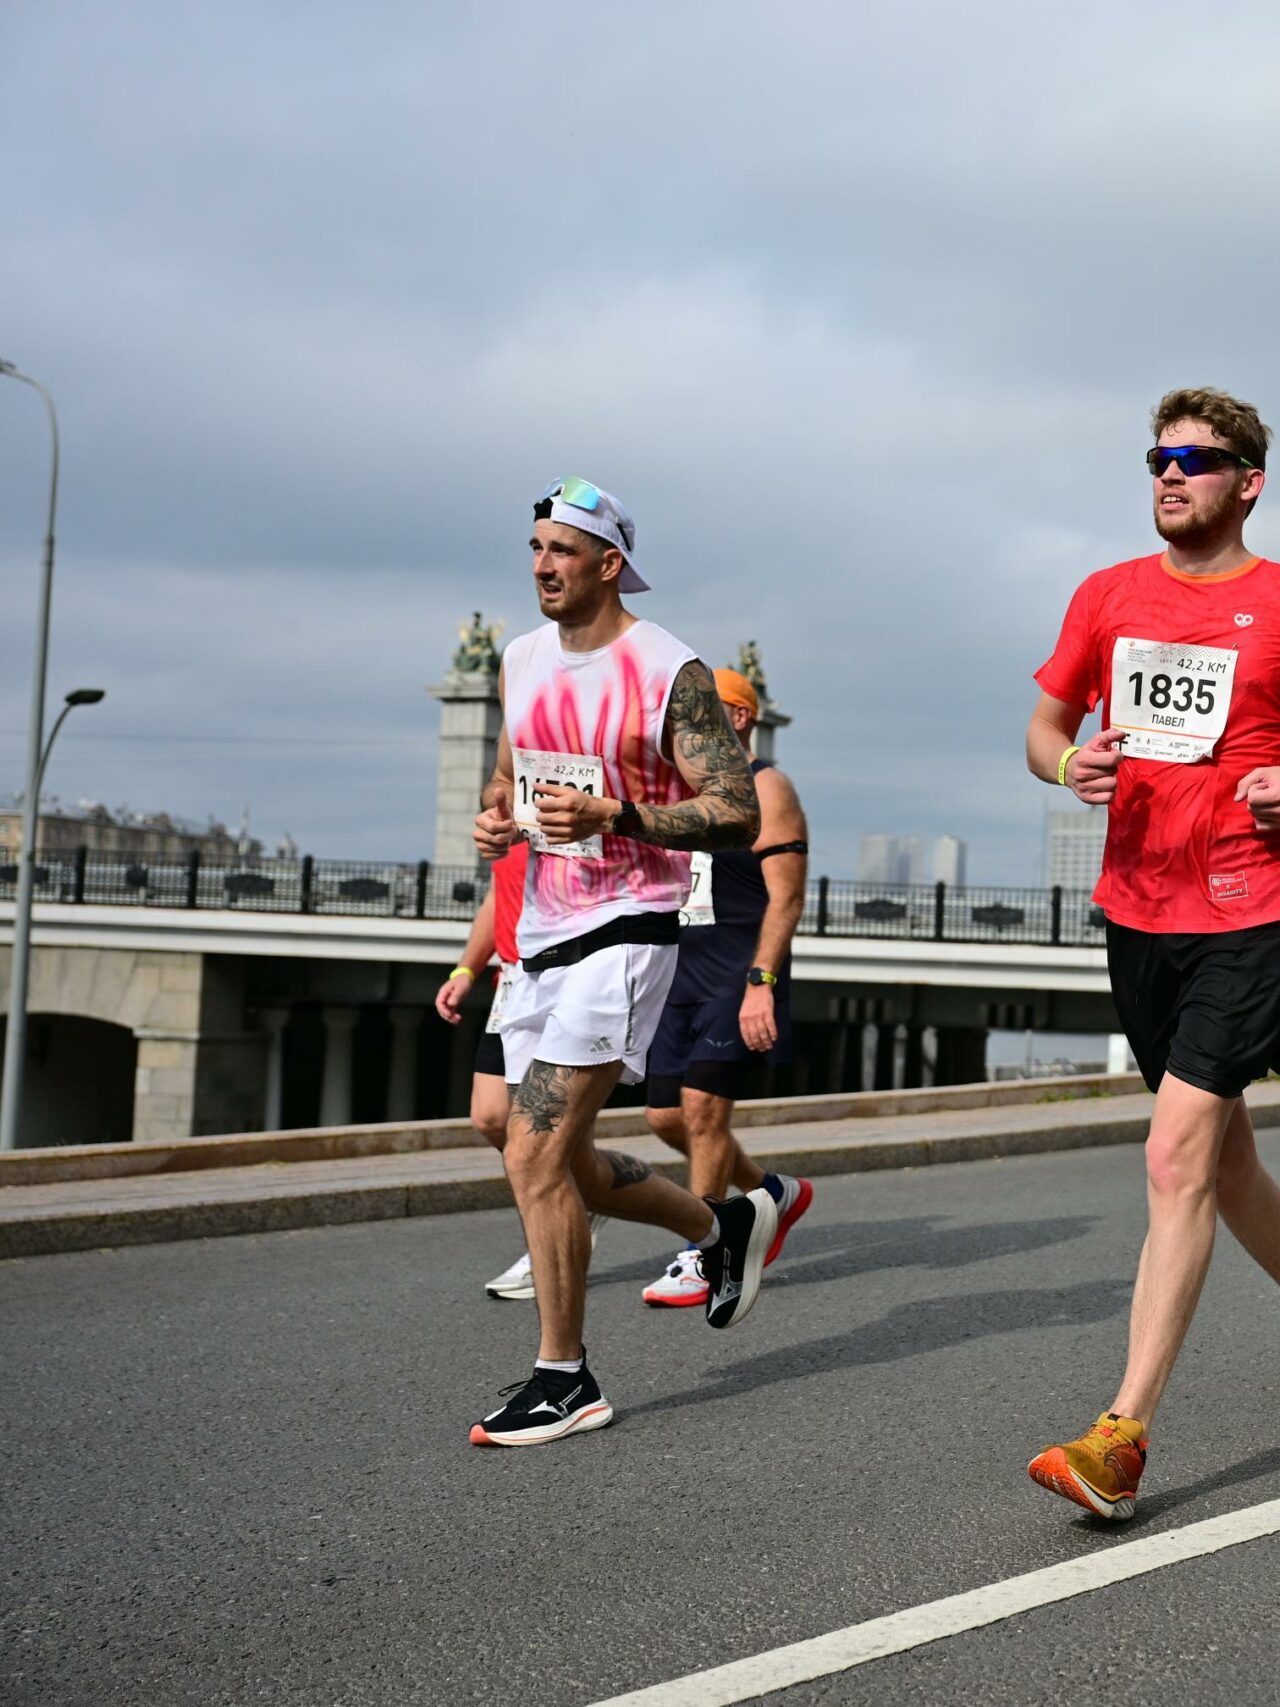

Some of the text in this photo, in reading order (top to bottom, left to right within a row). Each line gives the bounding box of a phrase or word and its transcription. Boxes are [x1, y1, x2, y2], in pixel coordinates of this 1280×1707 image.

[1177, 658, 1204, 671] 42,2
[1129, 671, 1217, 715] 1835
[1151, 714, 1185, 728] ПАВЕЛ
[554, 765, 575, 776] 42,2
